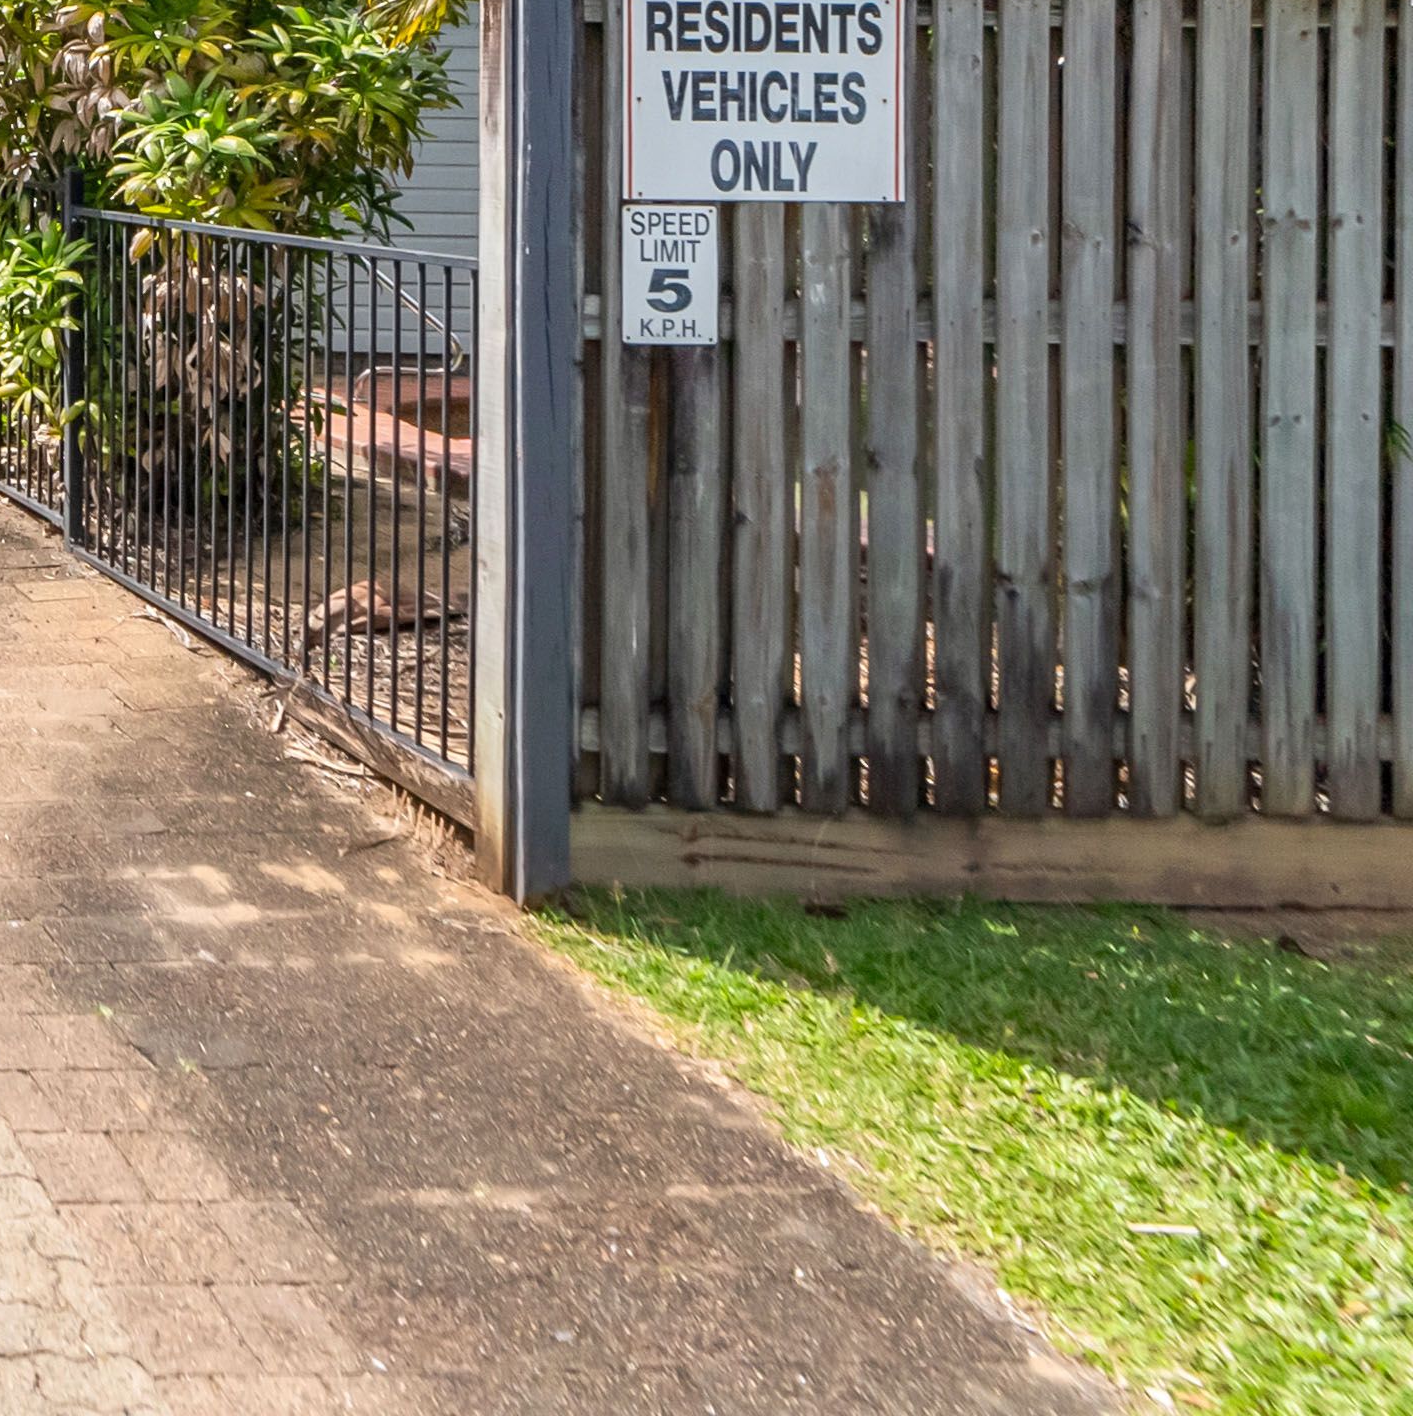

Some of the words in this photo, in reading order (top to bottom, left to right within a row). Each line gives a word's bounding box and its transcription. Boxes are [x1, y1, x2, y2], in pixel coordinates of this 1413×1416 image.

[645, 0, 883, 55] RESIDENTS
[661, 70, 867, 124] VEHICLES
[710, 139, 818, 192] ONLY
[630, 211, 710, 236] SPEED
[640, 240, 701, 263] LIMIT
[645, 268, 693, 313] 5
[640, 318, 702, 338] K.P.H.
